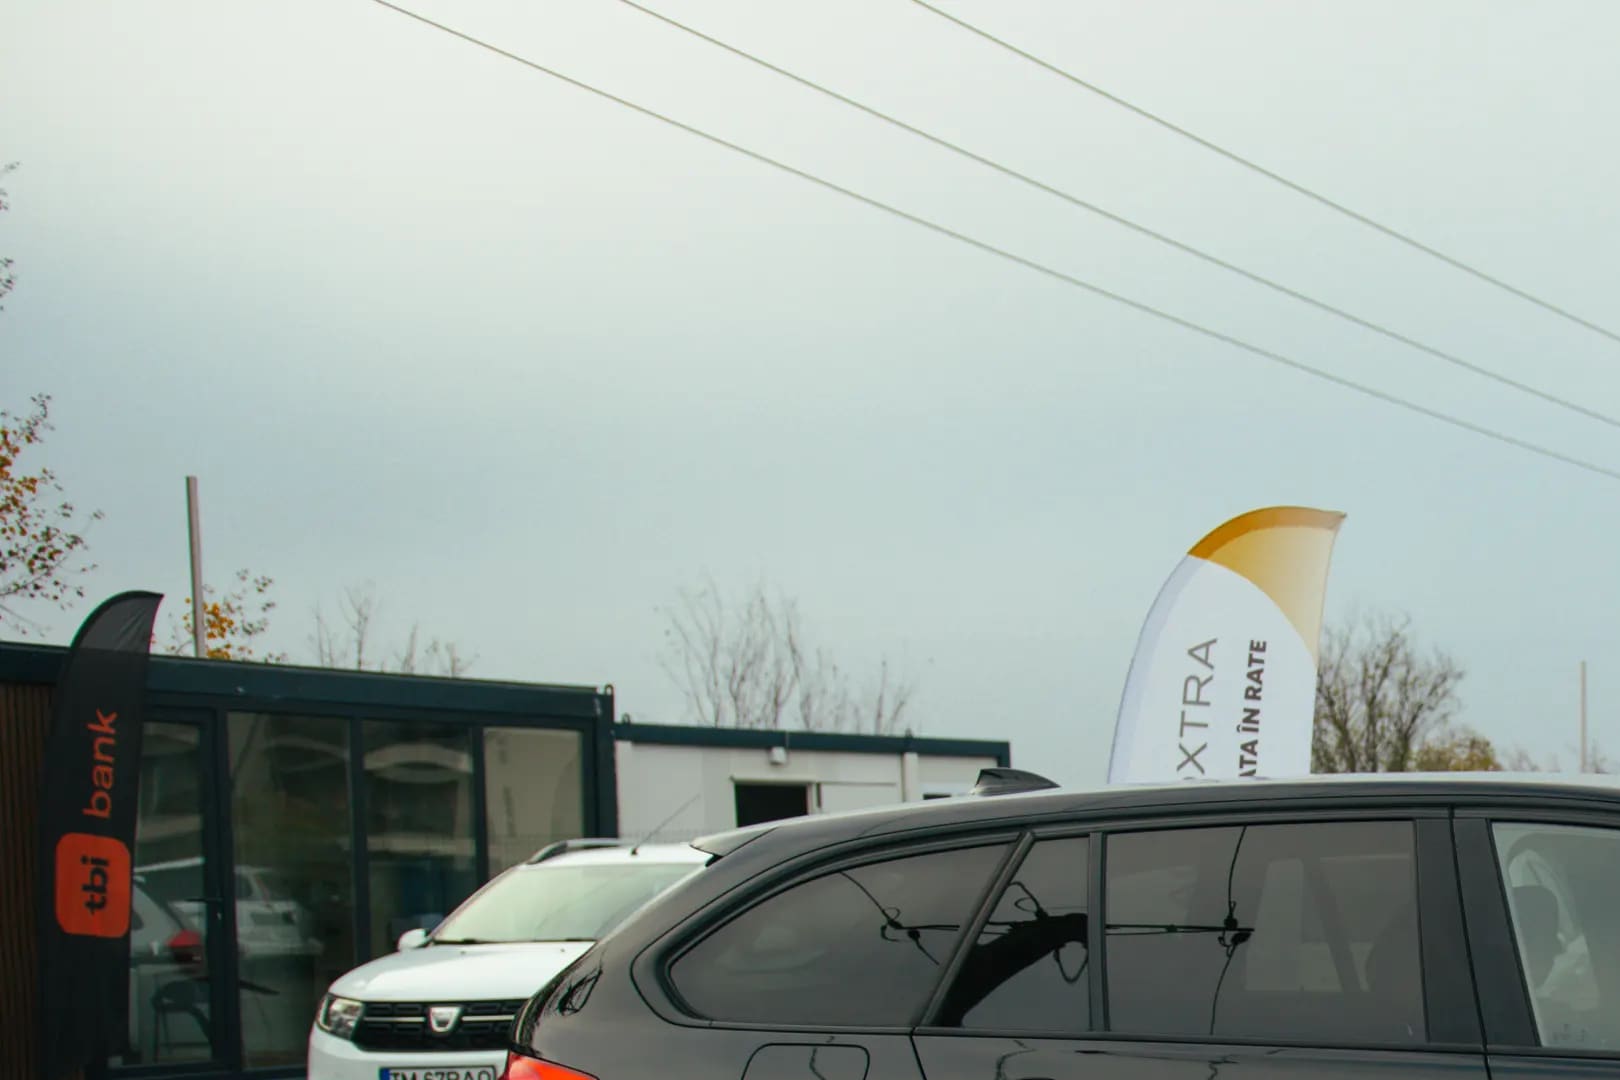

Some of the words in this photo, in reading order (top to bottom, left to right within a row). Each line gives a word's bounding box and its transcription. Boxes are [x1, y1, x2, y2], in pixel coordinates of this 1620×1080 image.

[1244, 639, 1267, 701] RATE
[1176, 637, 1218, 780] XTRA
[1236, 707, 1261, 733] ÎN
[82, 708, 118, 819] bank
[81, 855, 110, 916] tbi
